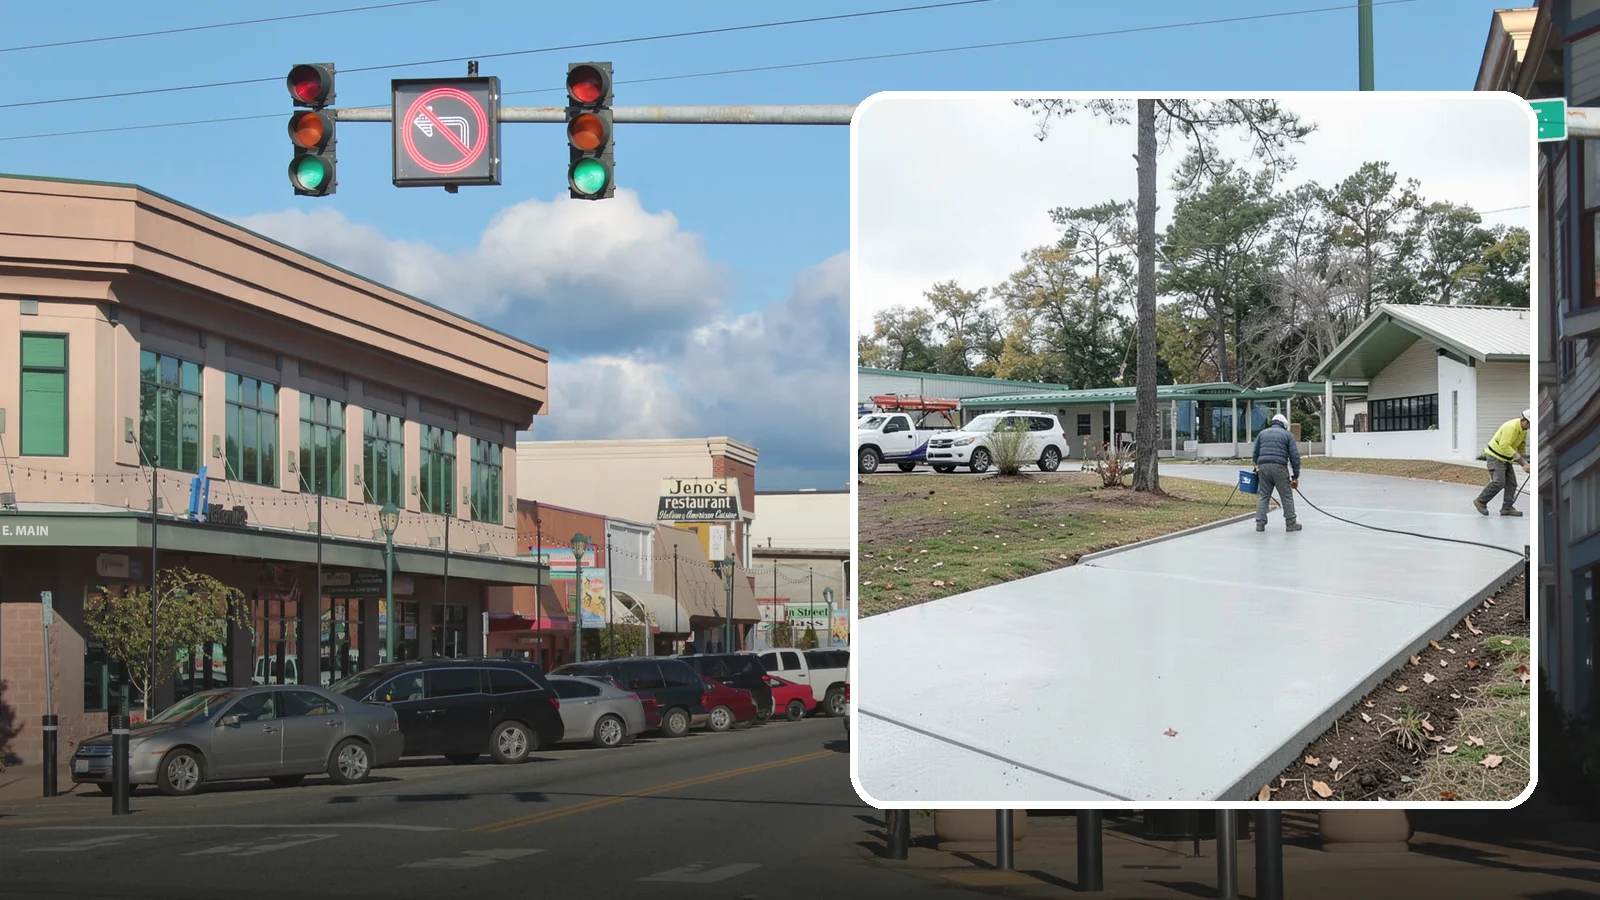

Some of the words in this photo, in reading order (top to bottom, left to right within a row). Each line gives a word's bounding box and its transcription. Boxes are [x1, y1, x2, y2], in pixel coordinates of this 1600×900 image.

[670, 480, 727, 494] Jeno's
[665, 497, 731, 509] restaurant
[658, 510, 681, 519] Italian
[686, 510, 714, 519] American
[715, 510, 737, 519] Cuisine
[2, 525, 13, 536] E.
[15, 525, 49, 536] MAIN
[797, 607, 828, 616] Street
